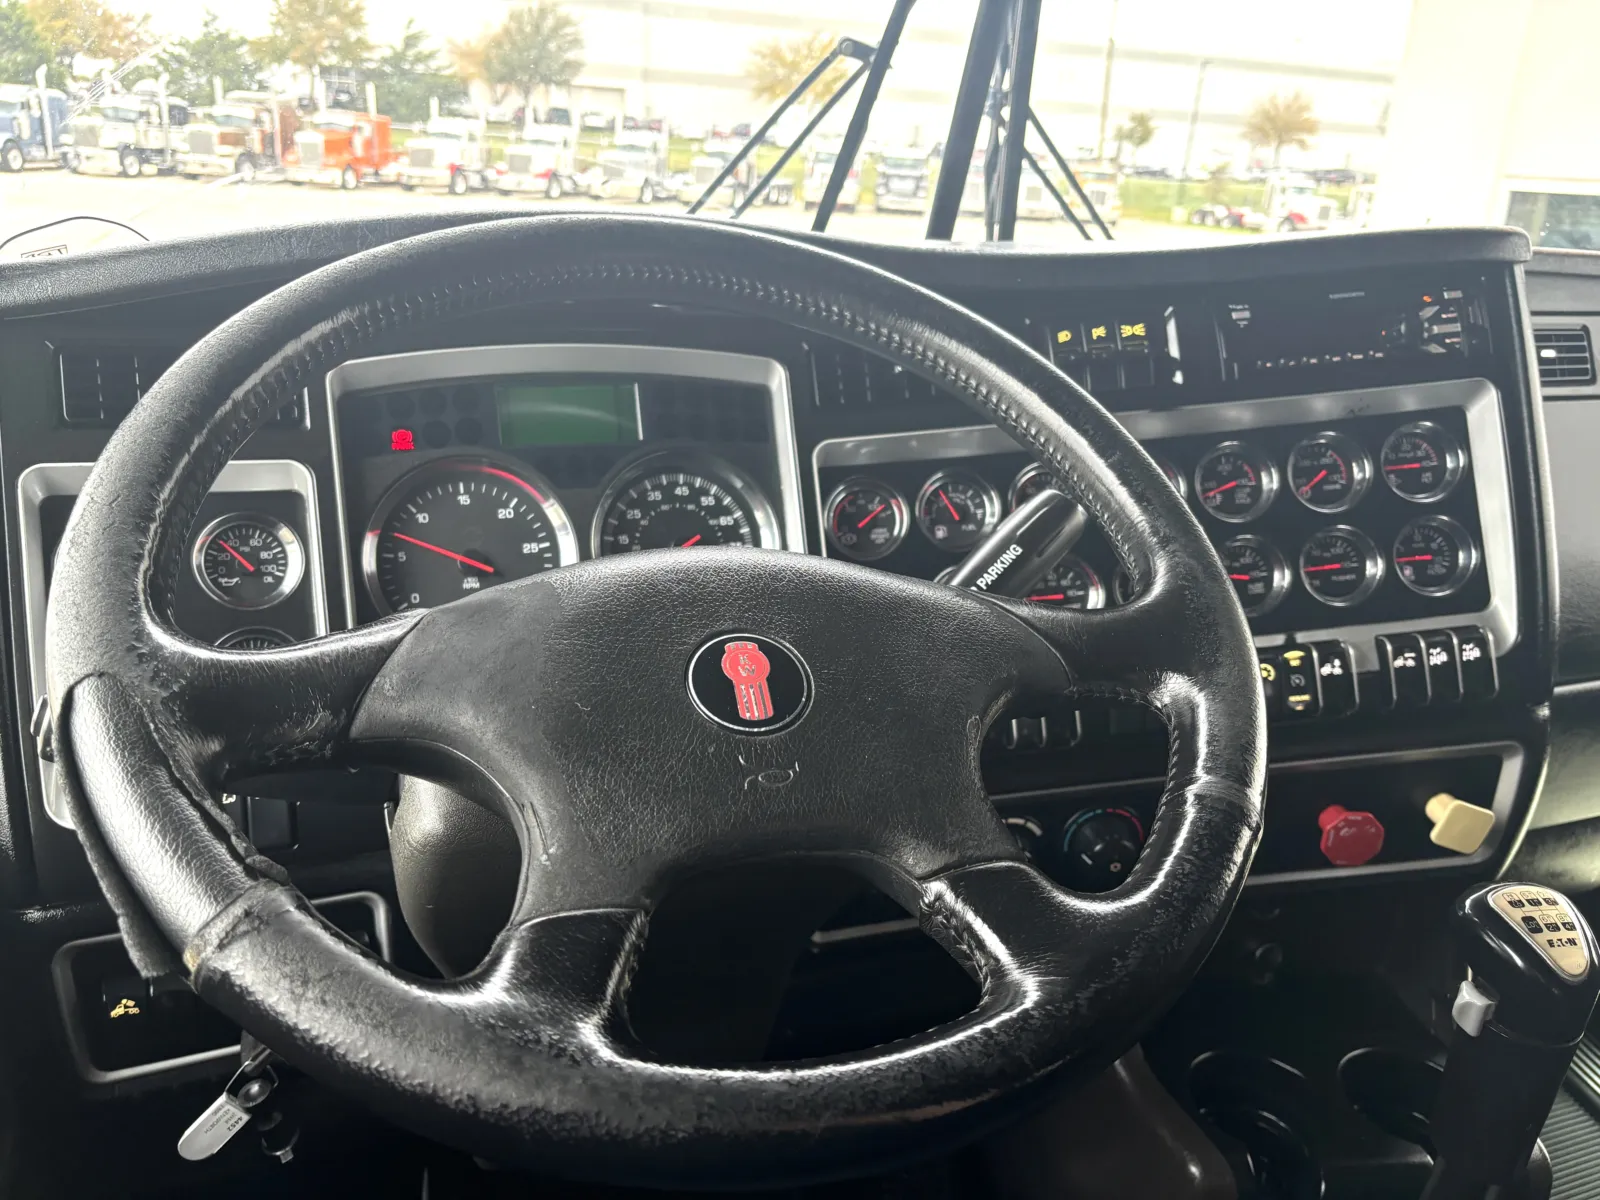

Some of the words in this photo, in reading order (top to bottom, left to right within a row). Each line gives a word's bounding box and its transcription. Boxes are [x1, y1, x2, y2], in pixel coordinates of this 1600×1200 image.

[648, 491, 662, 501] 35
[674, 486, 689, 496] 45
[457, 496, 470, 505] 15
[700, 496, 715, 506] 55
[416, 513, 429, 524] 10
[498, 509, 514, 518] 20
[627, 510, 642, 520] 25
[719, 516, 734, 526] 65
[618, 535, 629, 544] 15
[522, 544, 538, 554] 25
[260, 551, 272, 559] 80
[398, 552, 406, 562] 5
[976, 544, 1024, 590] PARKING
[411, 593, 420, 603] 0
[226, 1116, 243, 1132] 4452
